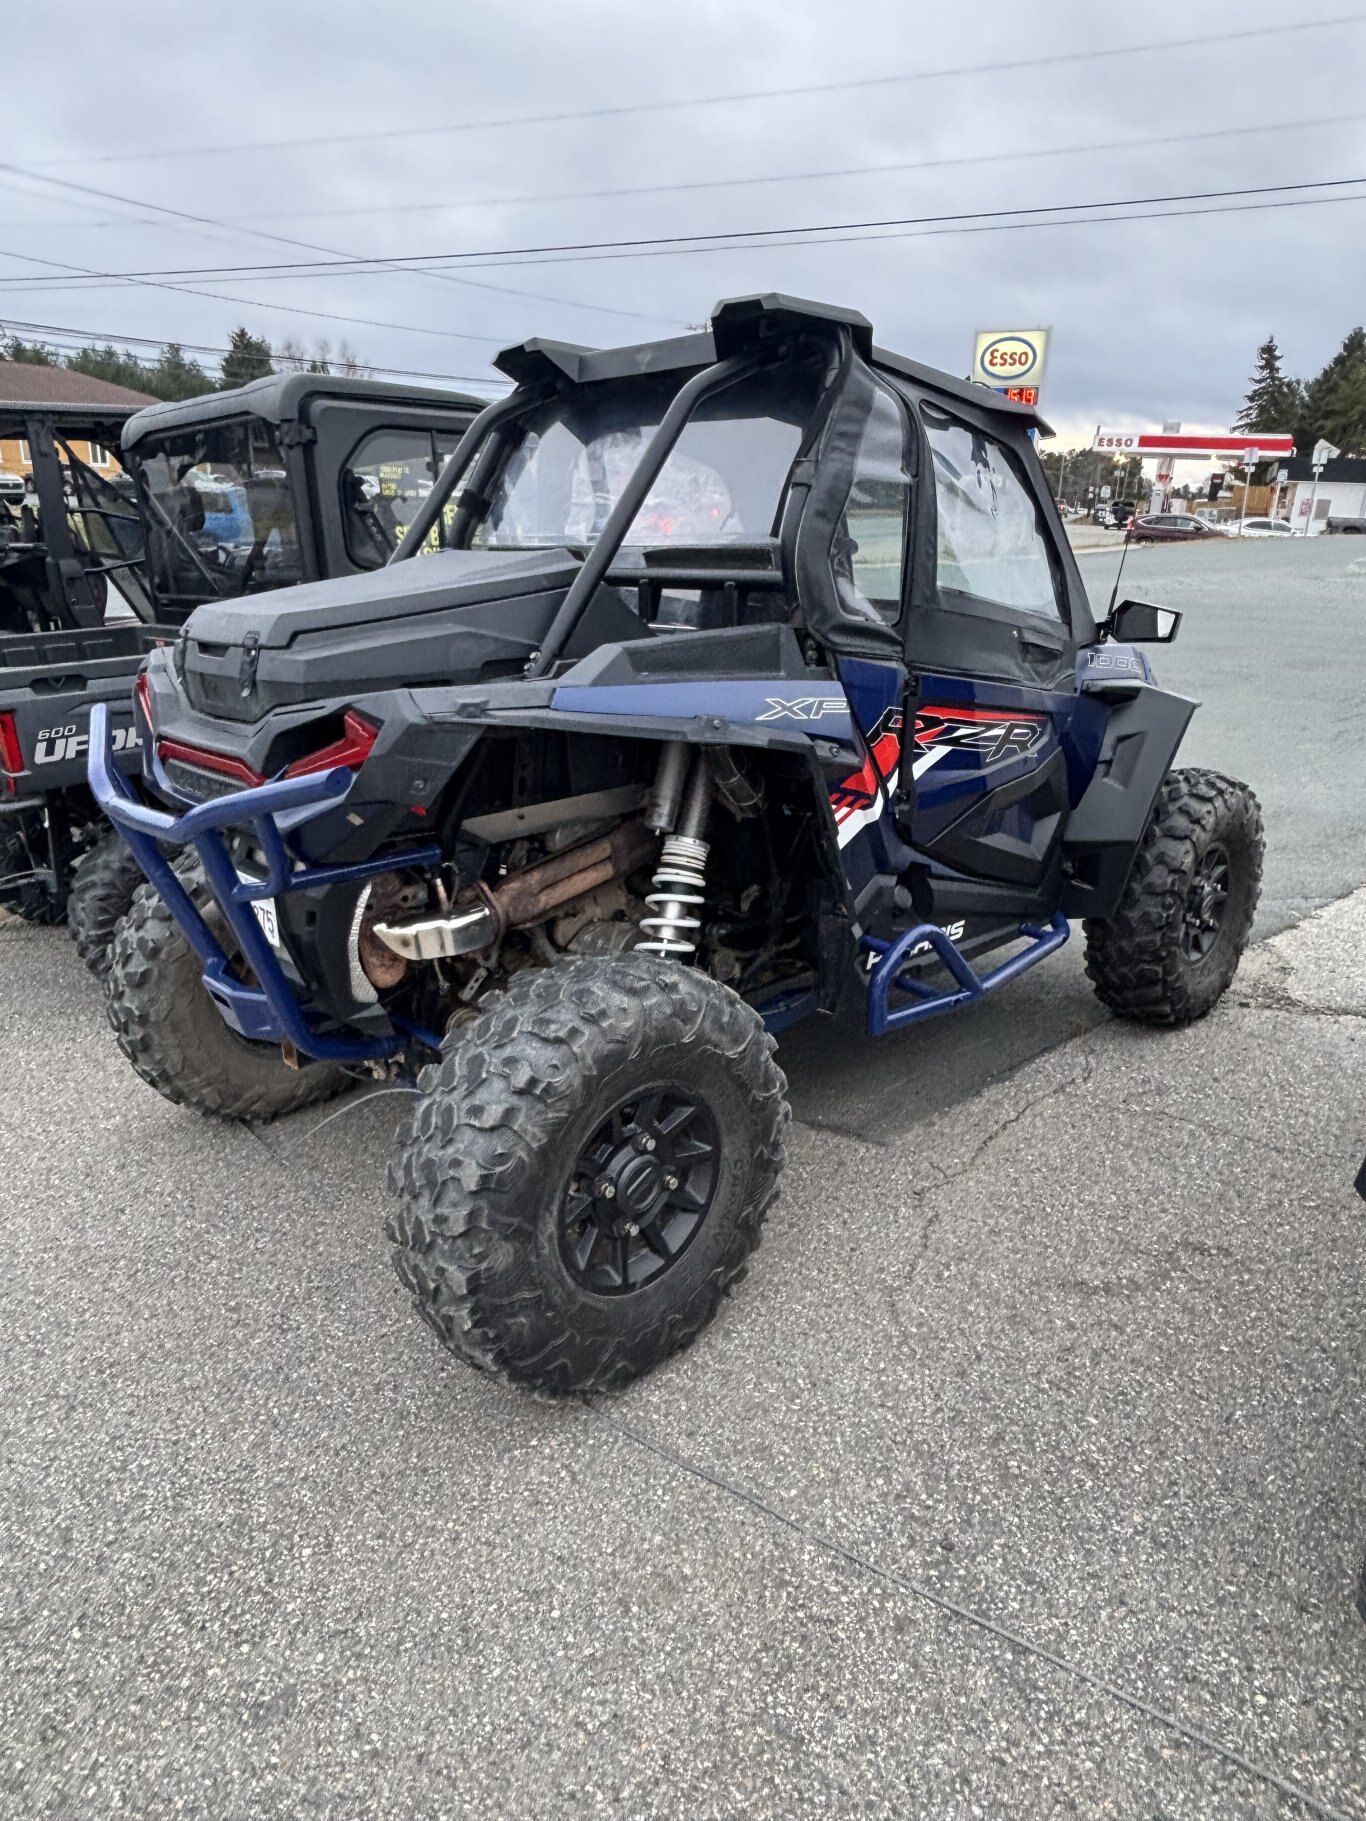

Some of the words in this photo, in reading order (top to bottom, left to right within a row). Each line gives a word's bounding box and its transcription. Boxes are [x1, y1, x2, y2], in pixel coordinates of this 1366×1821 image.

[988, 348, 1030, 367] Esso
[1098, 437, 1134, 448] ESSO
[755, 698, 850, 720] XP
[38, 725, 76, 740] 600
[866, 706, 1042, 762] RZR
